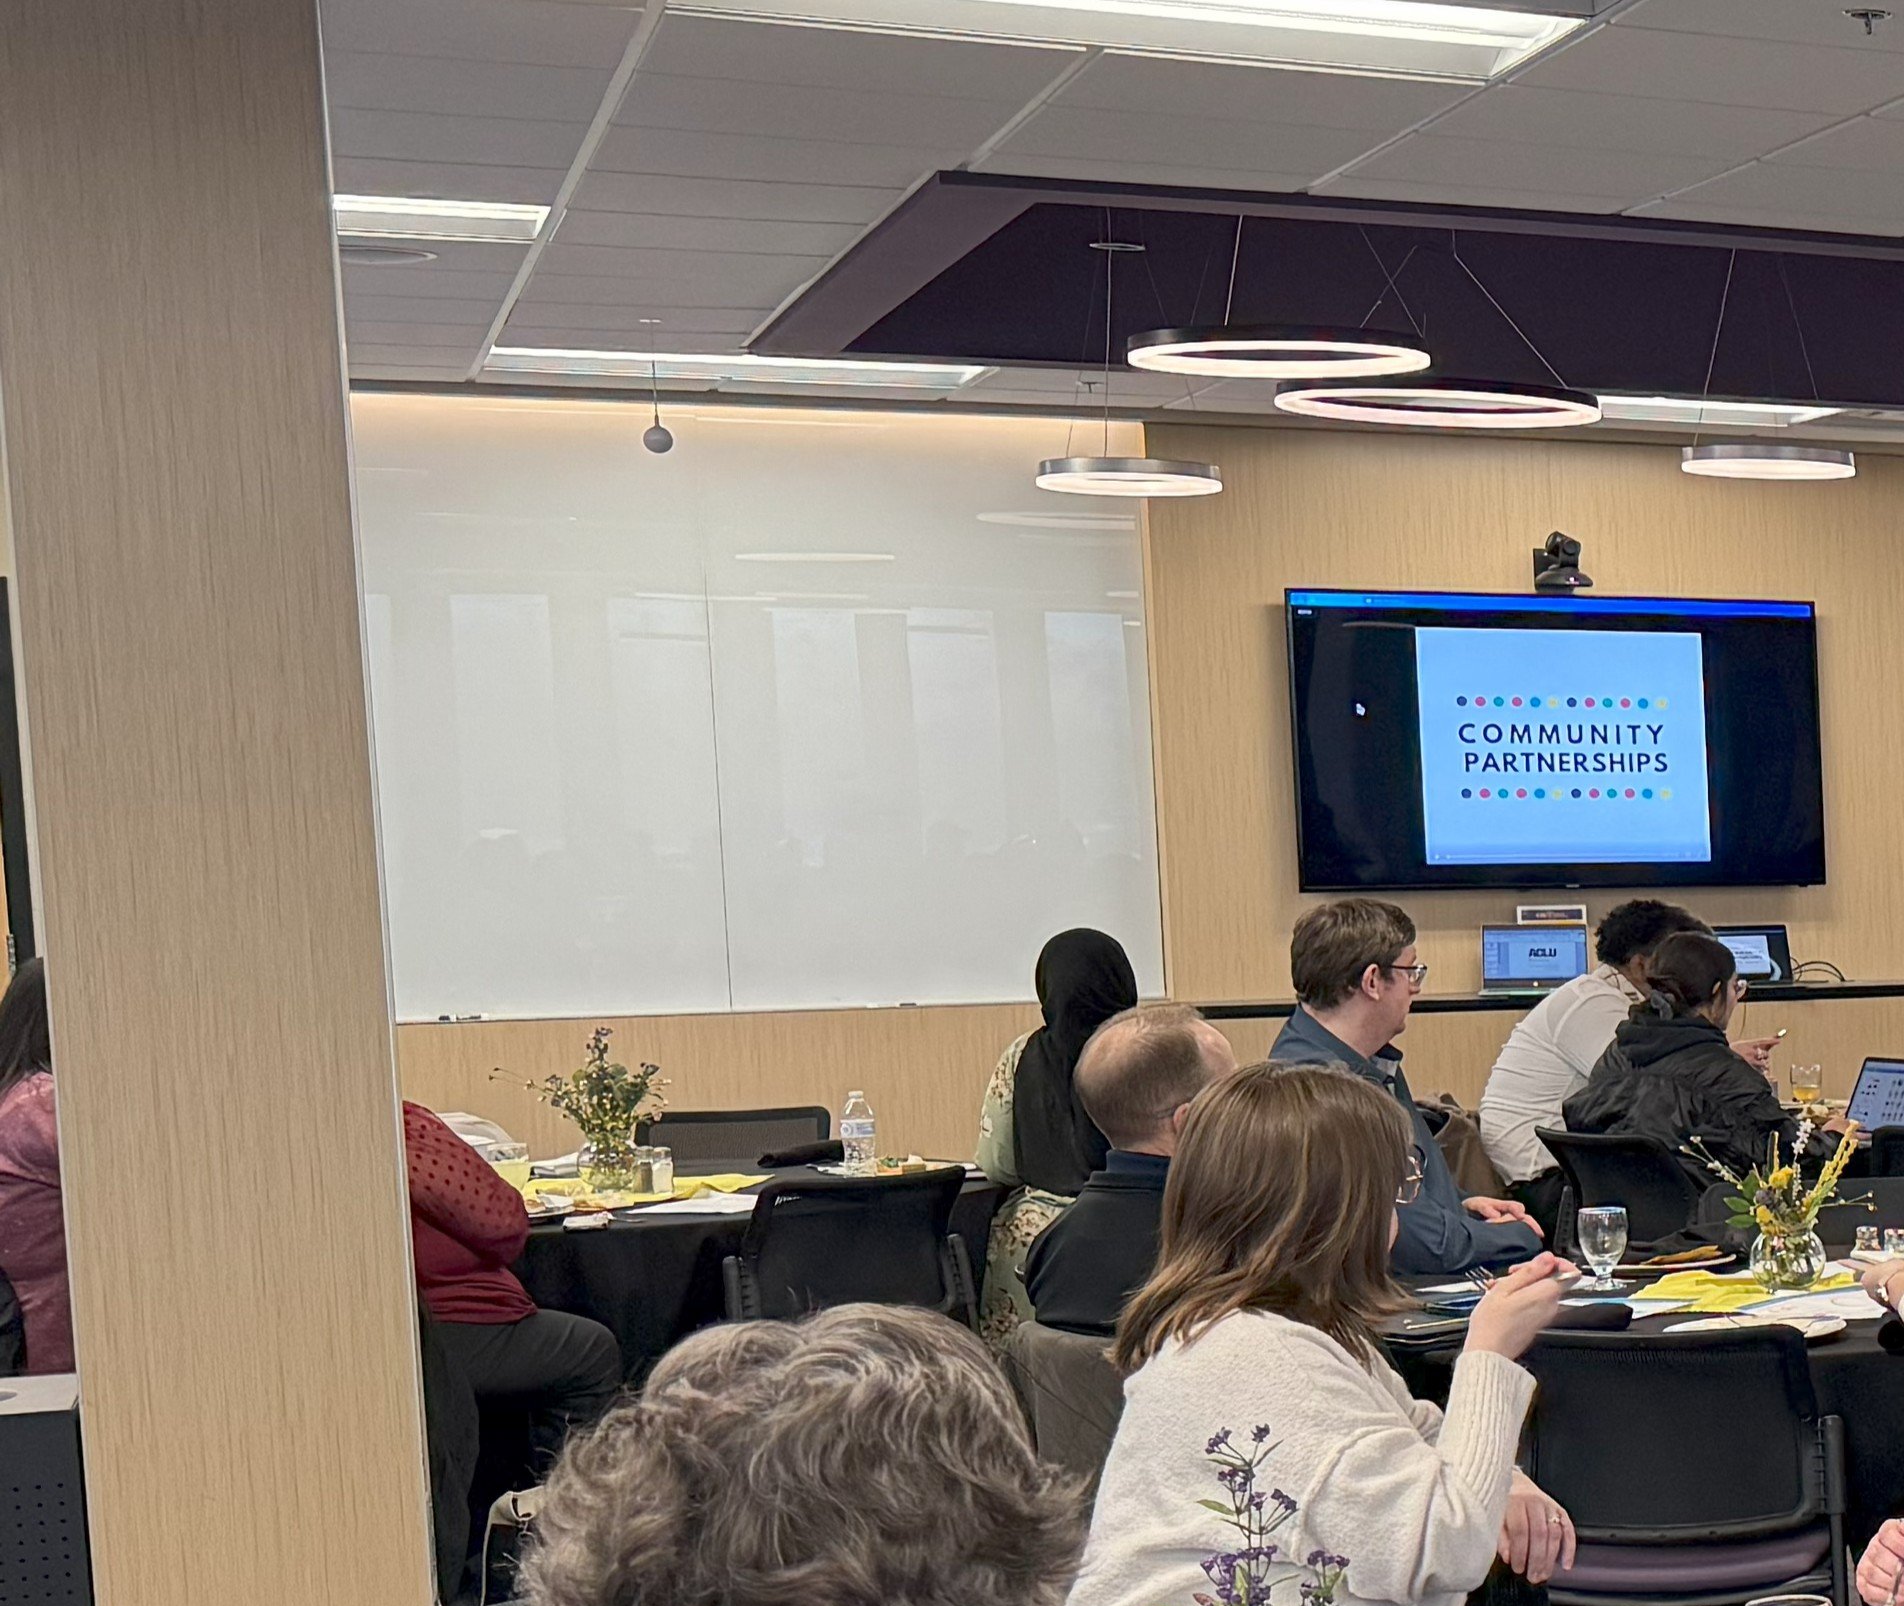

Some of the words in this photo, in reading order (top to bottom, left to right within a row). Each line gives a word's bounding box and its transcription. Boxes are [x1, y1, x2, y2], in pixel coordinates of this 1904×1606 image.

[1458, 722, 1665, 746] COMMUNITY
[1463, 751, 1669, 774] PARTNERSHIPS
[1528, 947, 1557, 958] ACLU
